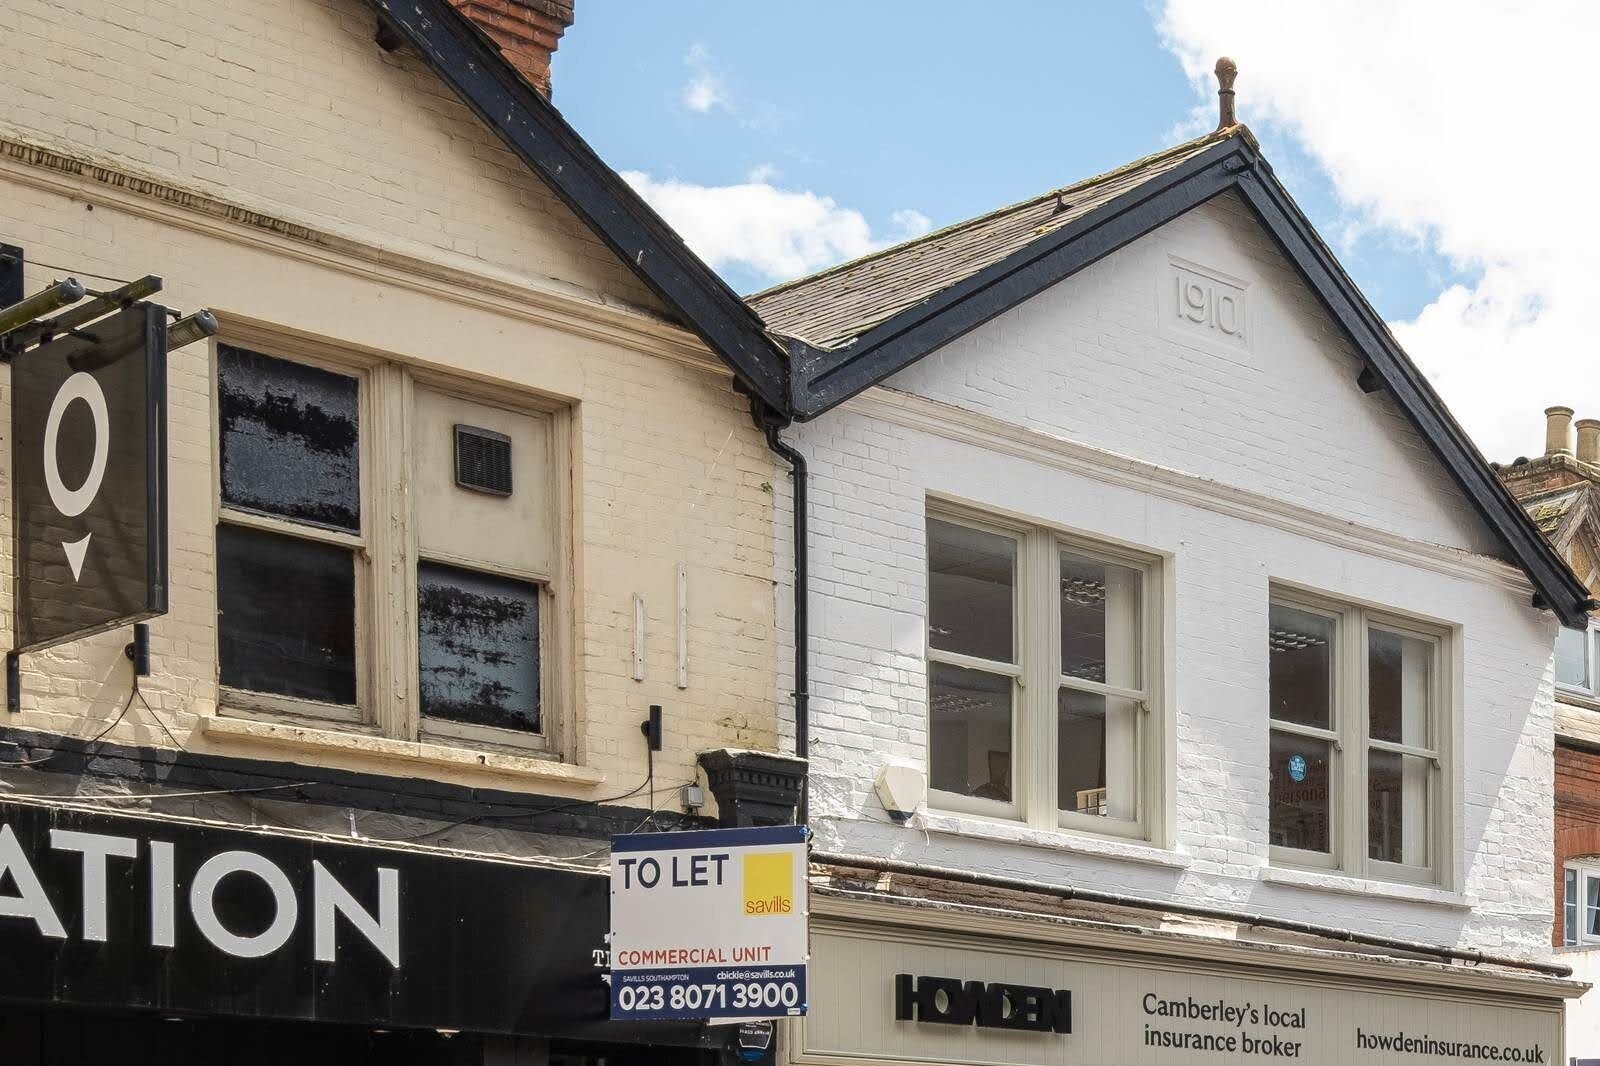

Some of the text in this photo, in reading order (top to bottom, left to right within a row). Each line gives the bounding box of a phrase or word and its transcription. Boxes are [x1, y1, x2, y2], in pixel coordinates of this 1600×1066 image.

[1175, 276, 1243, 337] 1910
[618, 854, 729, 889] TO LET
[746, 896, 791, 913] savills
[618, 946, 771, 965] COMMERCIAL UNIT
[646, 974, 689, 982] SOUTHAMPTON
[619, 982, 798, 1010] 023 8071 3900
[895, 974, 1072, 1034] HOWDEN
[1263, 1003, 1306, 1030] local
[1144, 1023, 1302, 1058] insurance broker
[1357, 1027, 1544, 1064] howdeninsurance.co.uk
